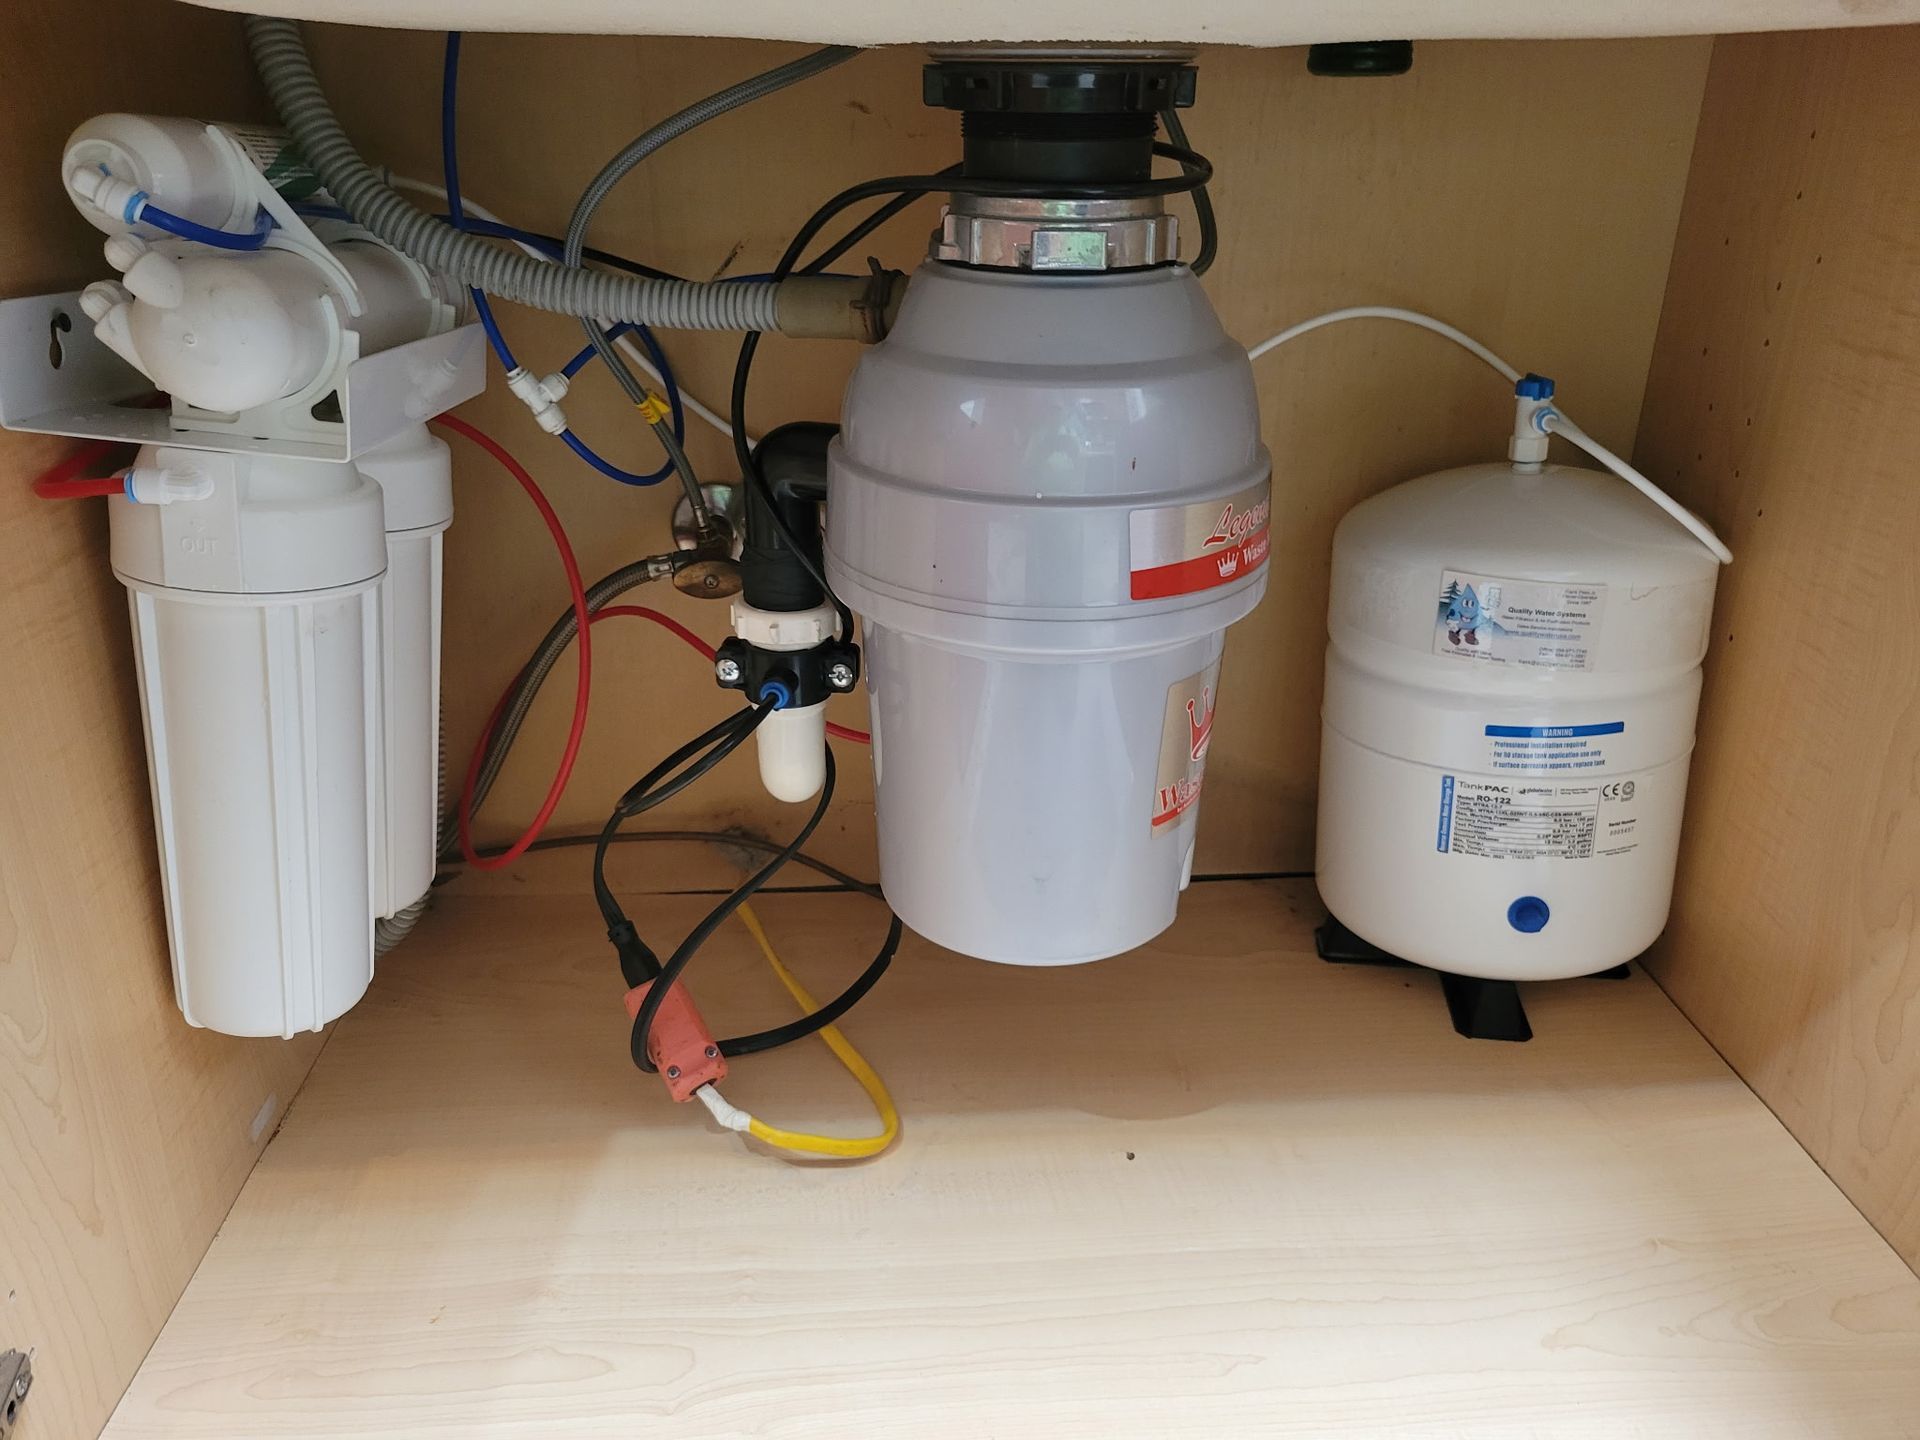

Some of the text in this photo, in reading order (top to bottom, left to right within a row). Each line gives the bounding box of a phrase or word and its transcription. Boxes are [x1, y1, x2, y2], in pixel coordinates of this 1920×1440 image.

[180, 535, 218, 554] OUT
[1508, 606, 1586, 618] Quality Water Systems
[1542, 728, 1574, 737] WARNING
[1458, 780, 1510, 793] TankPAC
[1476, 795, 1511, 805] RO-122
